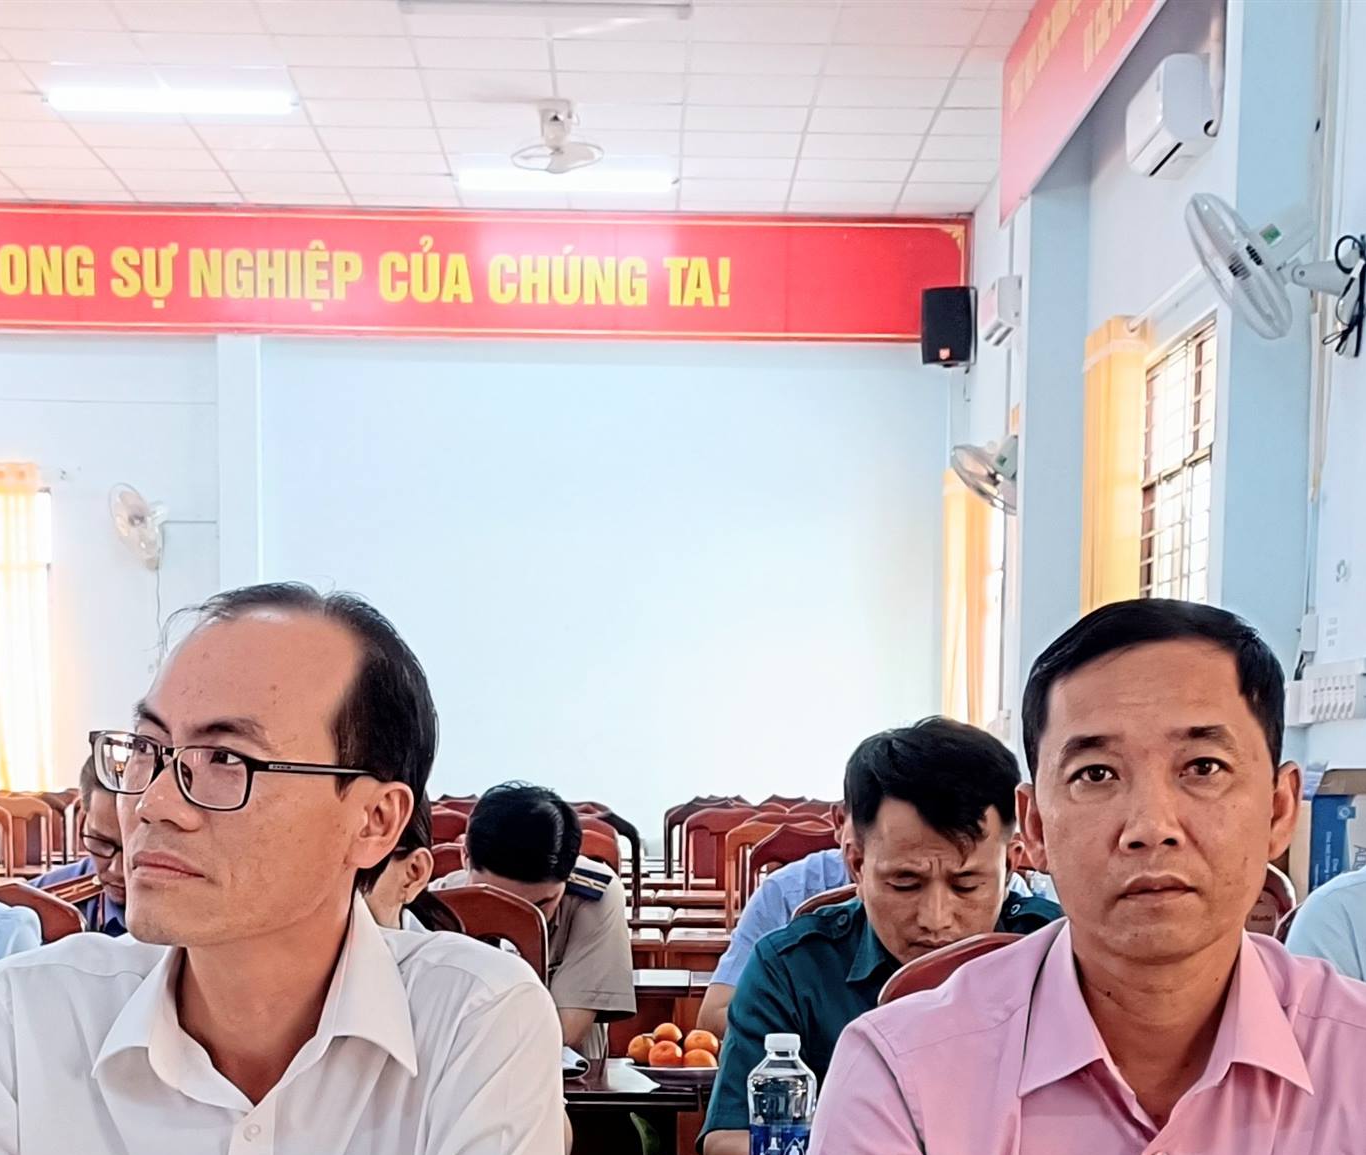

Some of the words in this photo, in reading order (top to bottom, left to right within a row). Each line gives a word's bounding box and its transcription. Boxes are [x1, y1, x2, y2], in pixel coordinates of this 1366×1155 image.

[109, 242, 179, 309] SỰ
[188, 239, 363, 312] NGHIỆP
[377, 235, 473, 304] CỦA
[487, 244, 648, 305] CHÚNG
[662, 256, 731, 307] TA!
